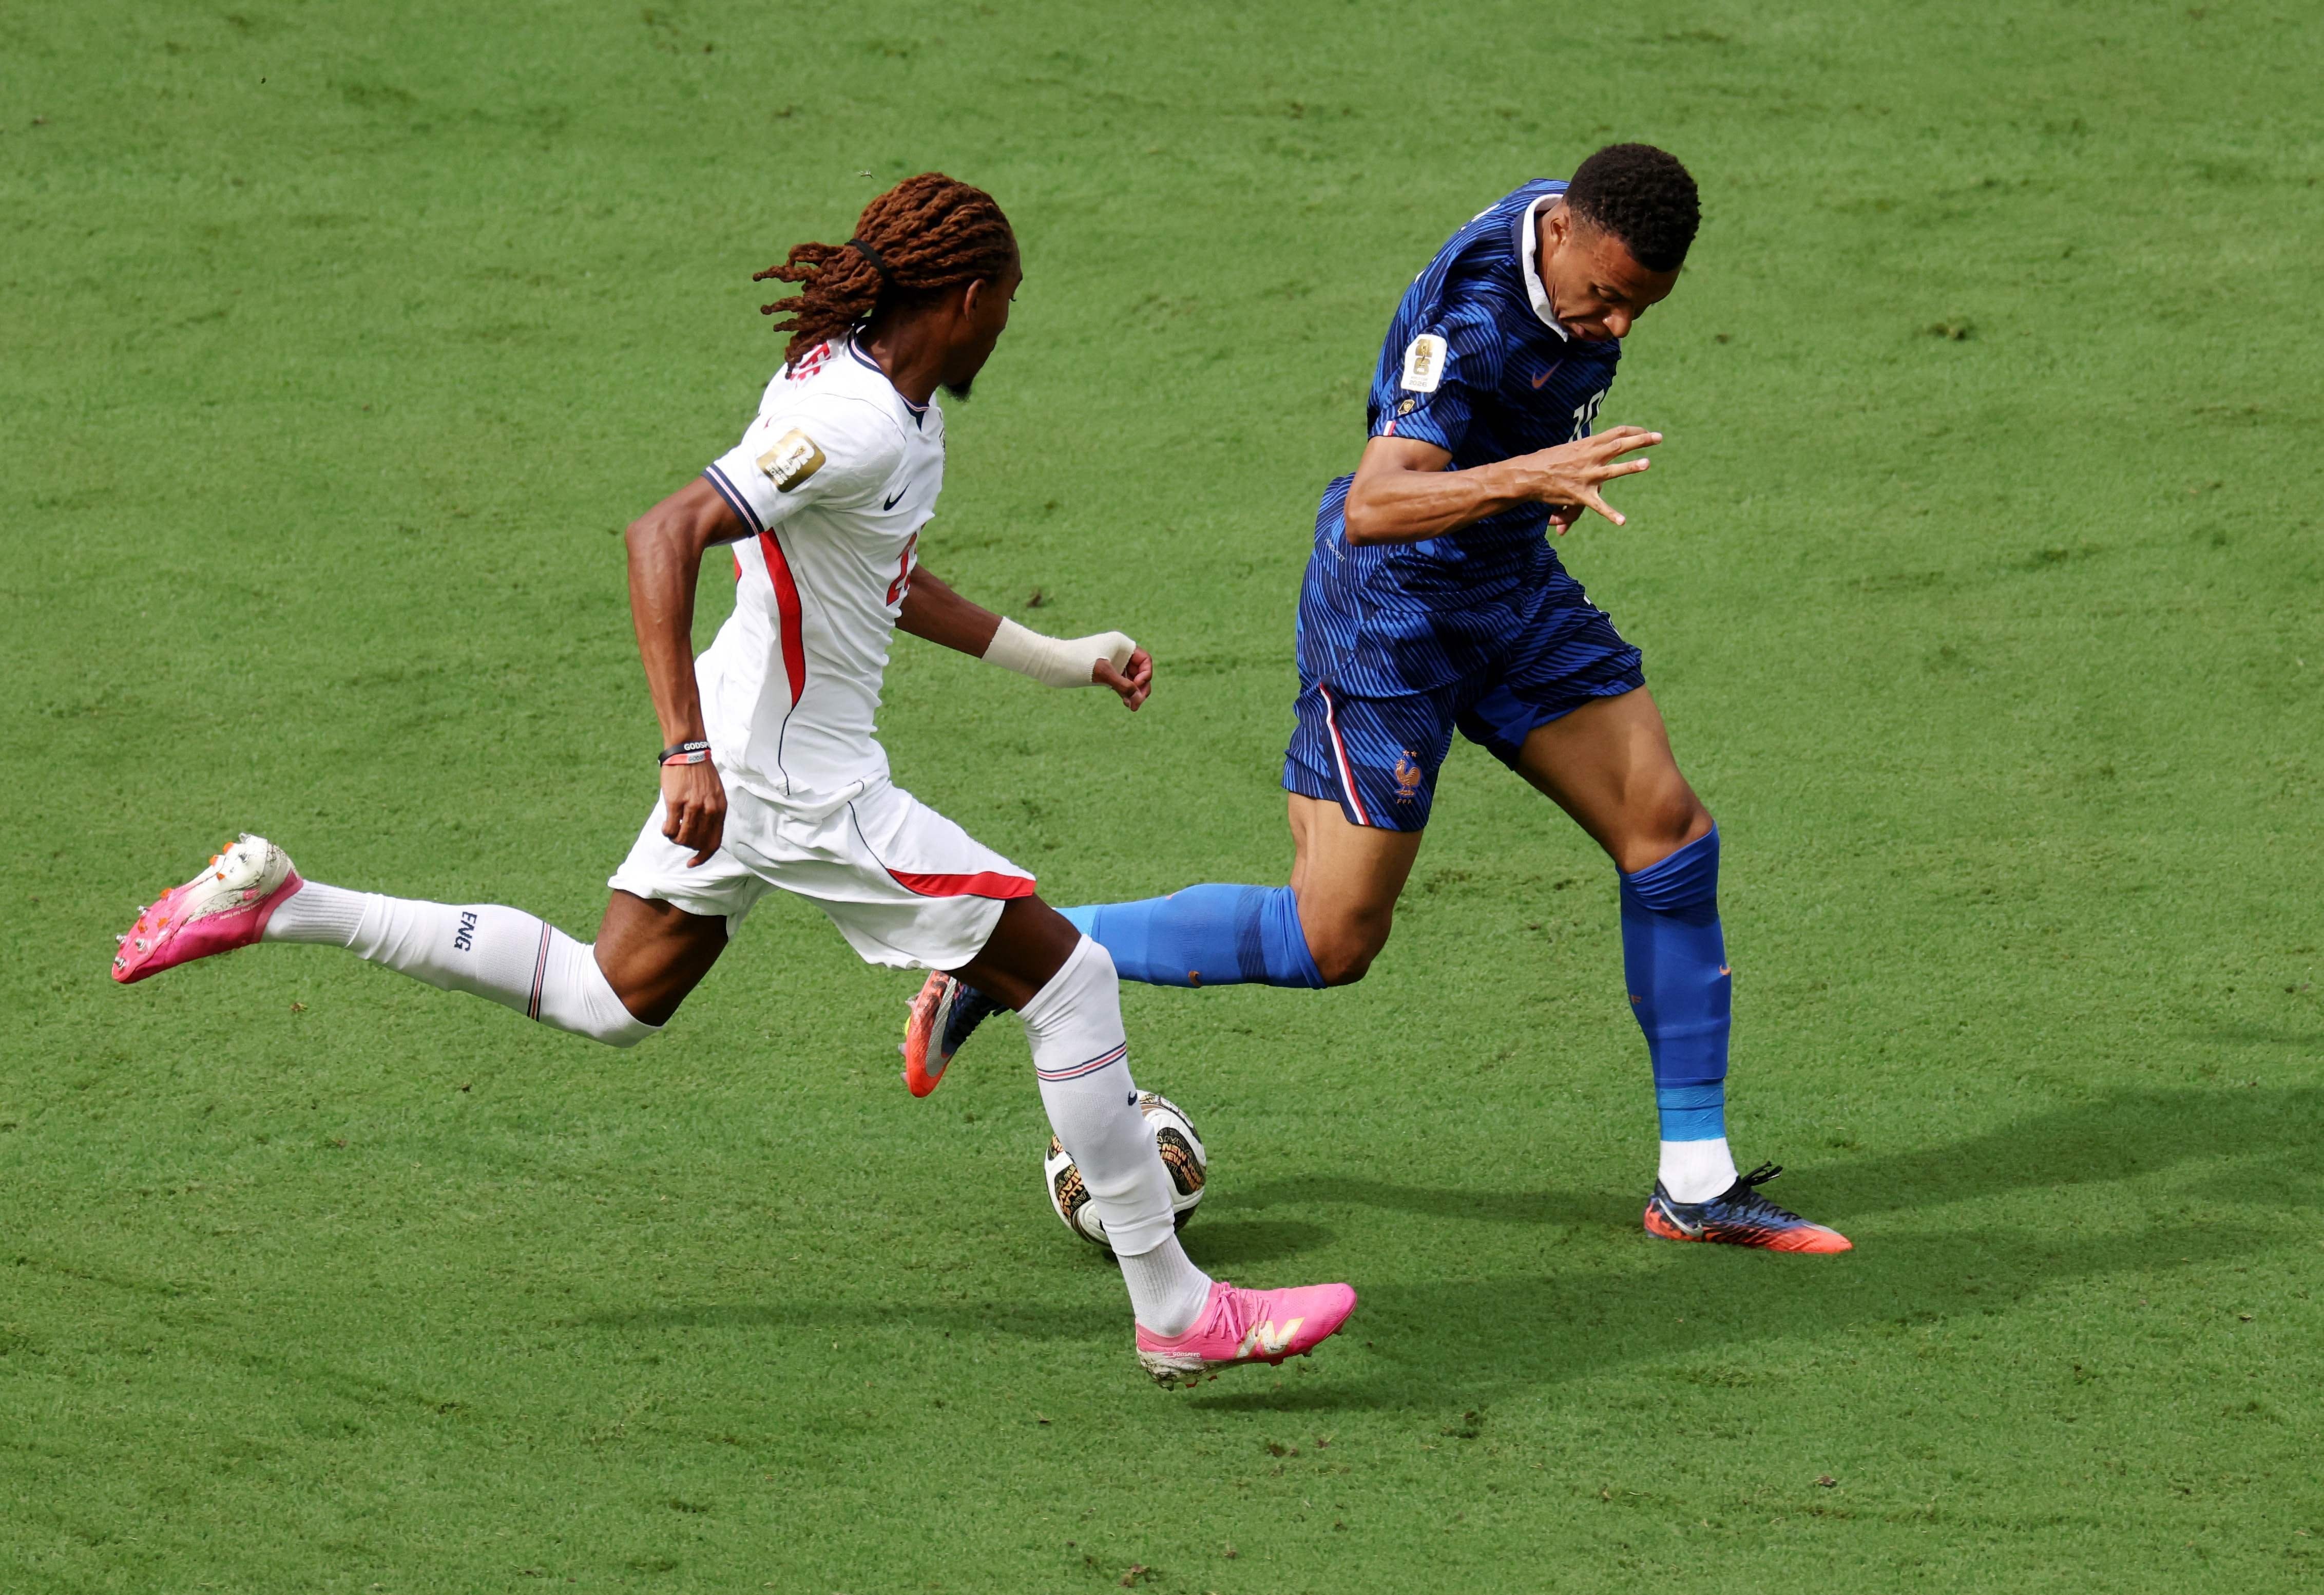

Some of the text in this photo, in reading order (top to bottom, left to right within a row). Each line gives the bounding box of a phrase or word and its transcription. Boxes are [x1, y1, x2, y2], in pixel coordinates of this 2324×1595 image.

[454, 911, 478, 952] ENG
[1161, 1151, 1181, 1166] NEW
[1162, 1143, 1187, 1161] NEW
